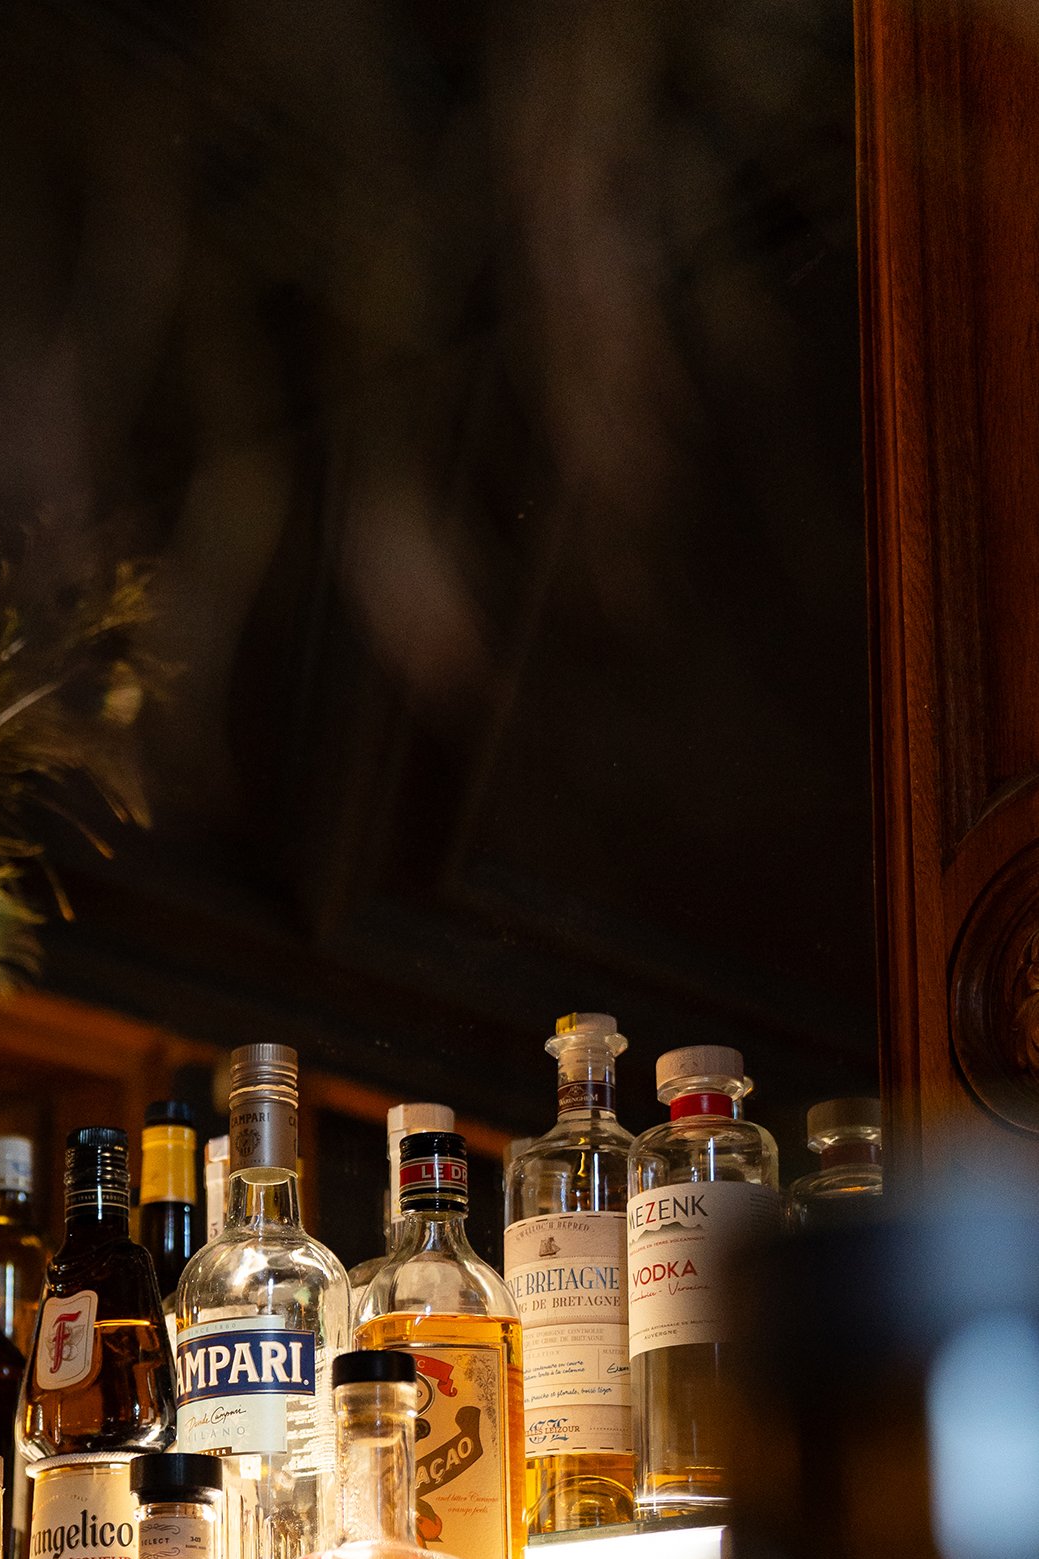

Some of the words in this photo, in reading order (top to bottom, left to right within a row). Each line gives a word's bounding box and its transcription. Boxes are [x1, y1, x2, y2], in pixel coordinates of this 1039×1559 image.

[421, 1165, 444, 1179] LE
[526, 1265, 620, 1296] BRETAGNE
[632, 1259, 698, 1288] VODKA
[532, 1299, 547, 1311] DE
[552, 1295, 621, 1309] BRETAGNE
[544, 1425, 581, 1434] LEIZOUR
